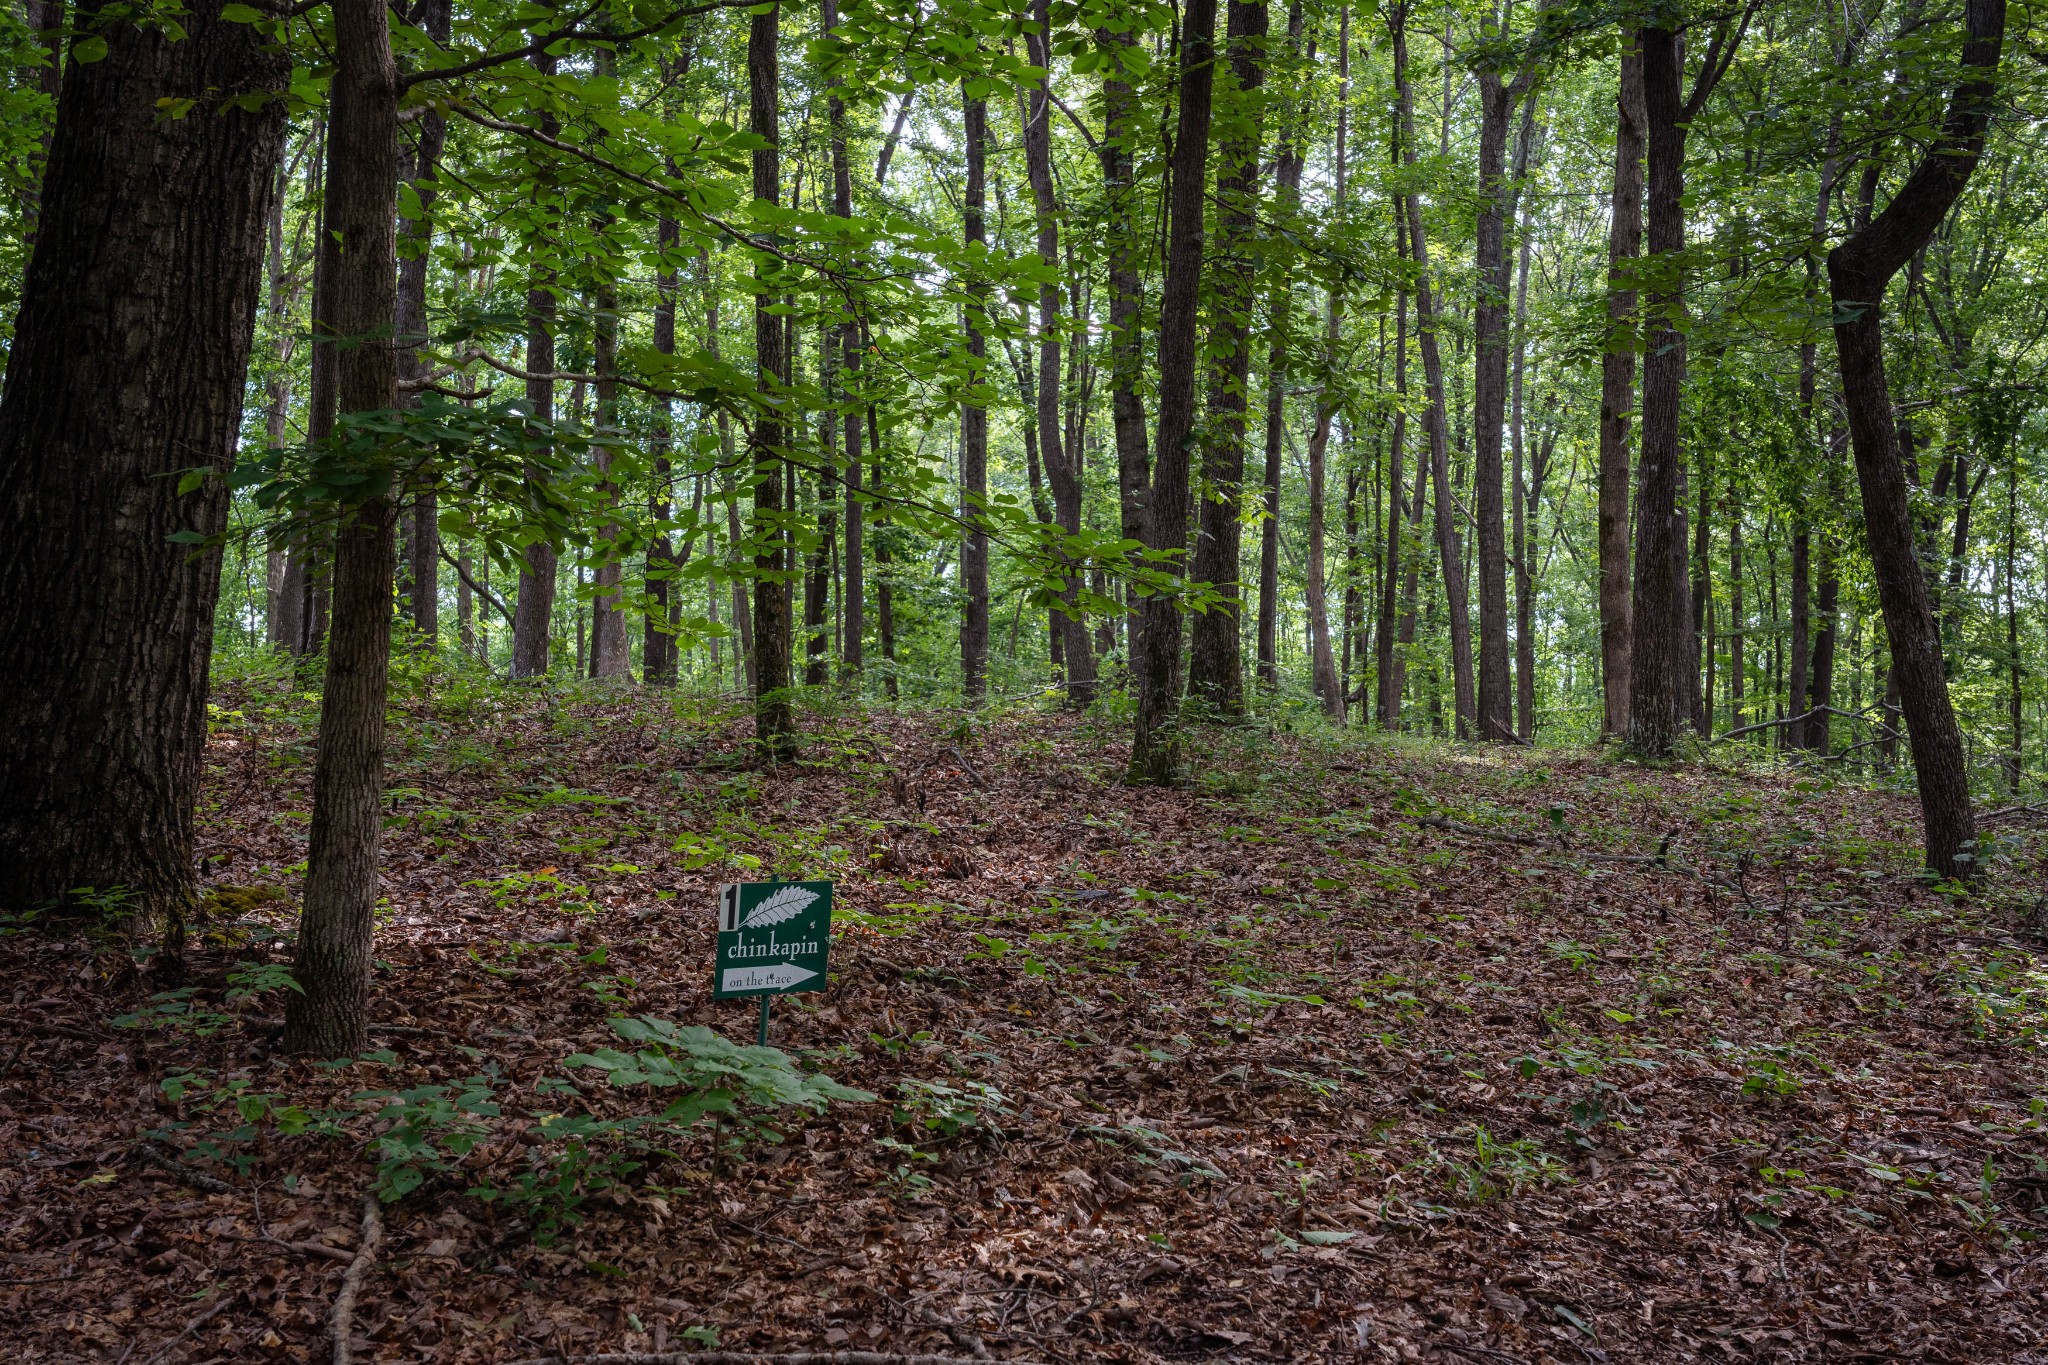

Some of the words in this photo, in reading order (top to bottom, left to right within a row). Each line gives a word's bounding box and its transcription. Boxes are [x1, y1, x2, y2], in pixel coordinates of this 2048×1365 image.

[725, 884, 738, 930] 1
[727, 930, 818, 961] chinkapin
[729, 979, 742, 988] on
[746, 971, 763, 986] the
[766, 974, 792, 985] trace
